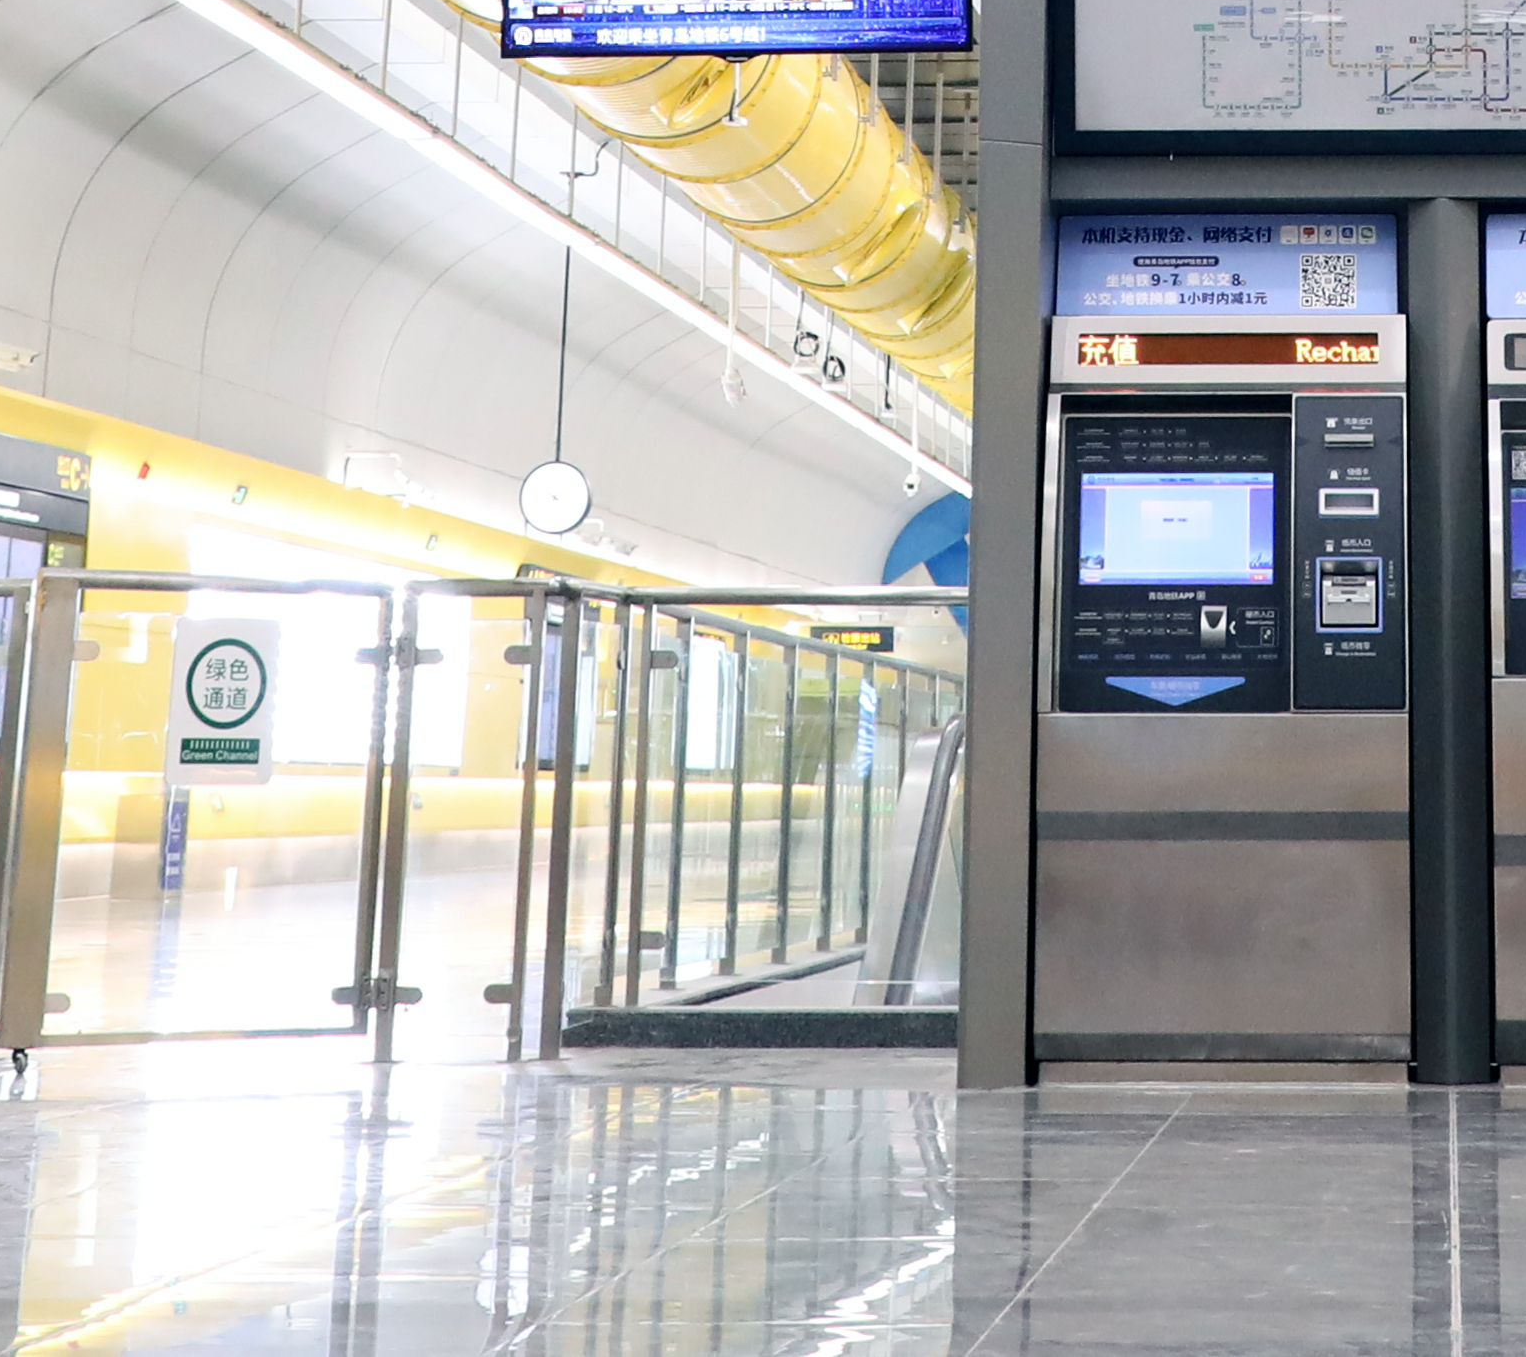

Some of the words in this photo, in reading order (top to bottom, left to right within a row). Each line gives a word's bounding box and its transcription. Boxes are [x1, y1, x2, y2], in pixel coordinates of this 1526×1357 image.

[1080, 335, 1139, 366] 充值
[205, 657, 250, 682] 绿色
[202, 687, 248, 710] 通道
[181, 749, 214, 761] Green
[215, 749, 259, 761] Channel
